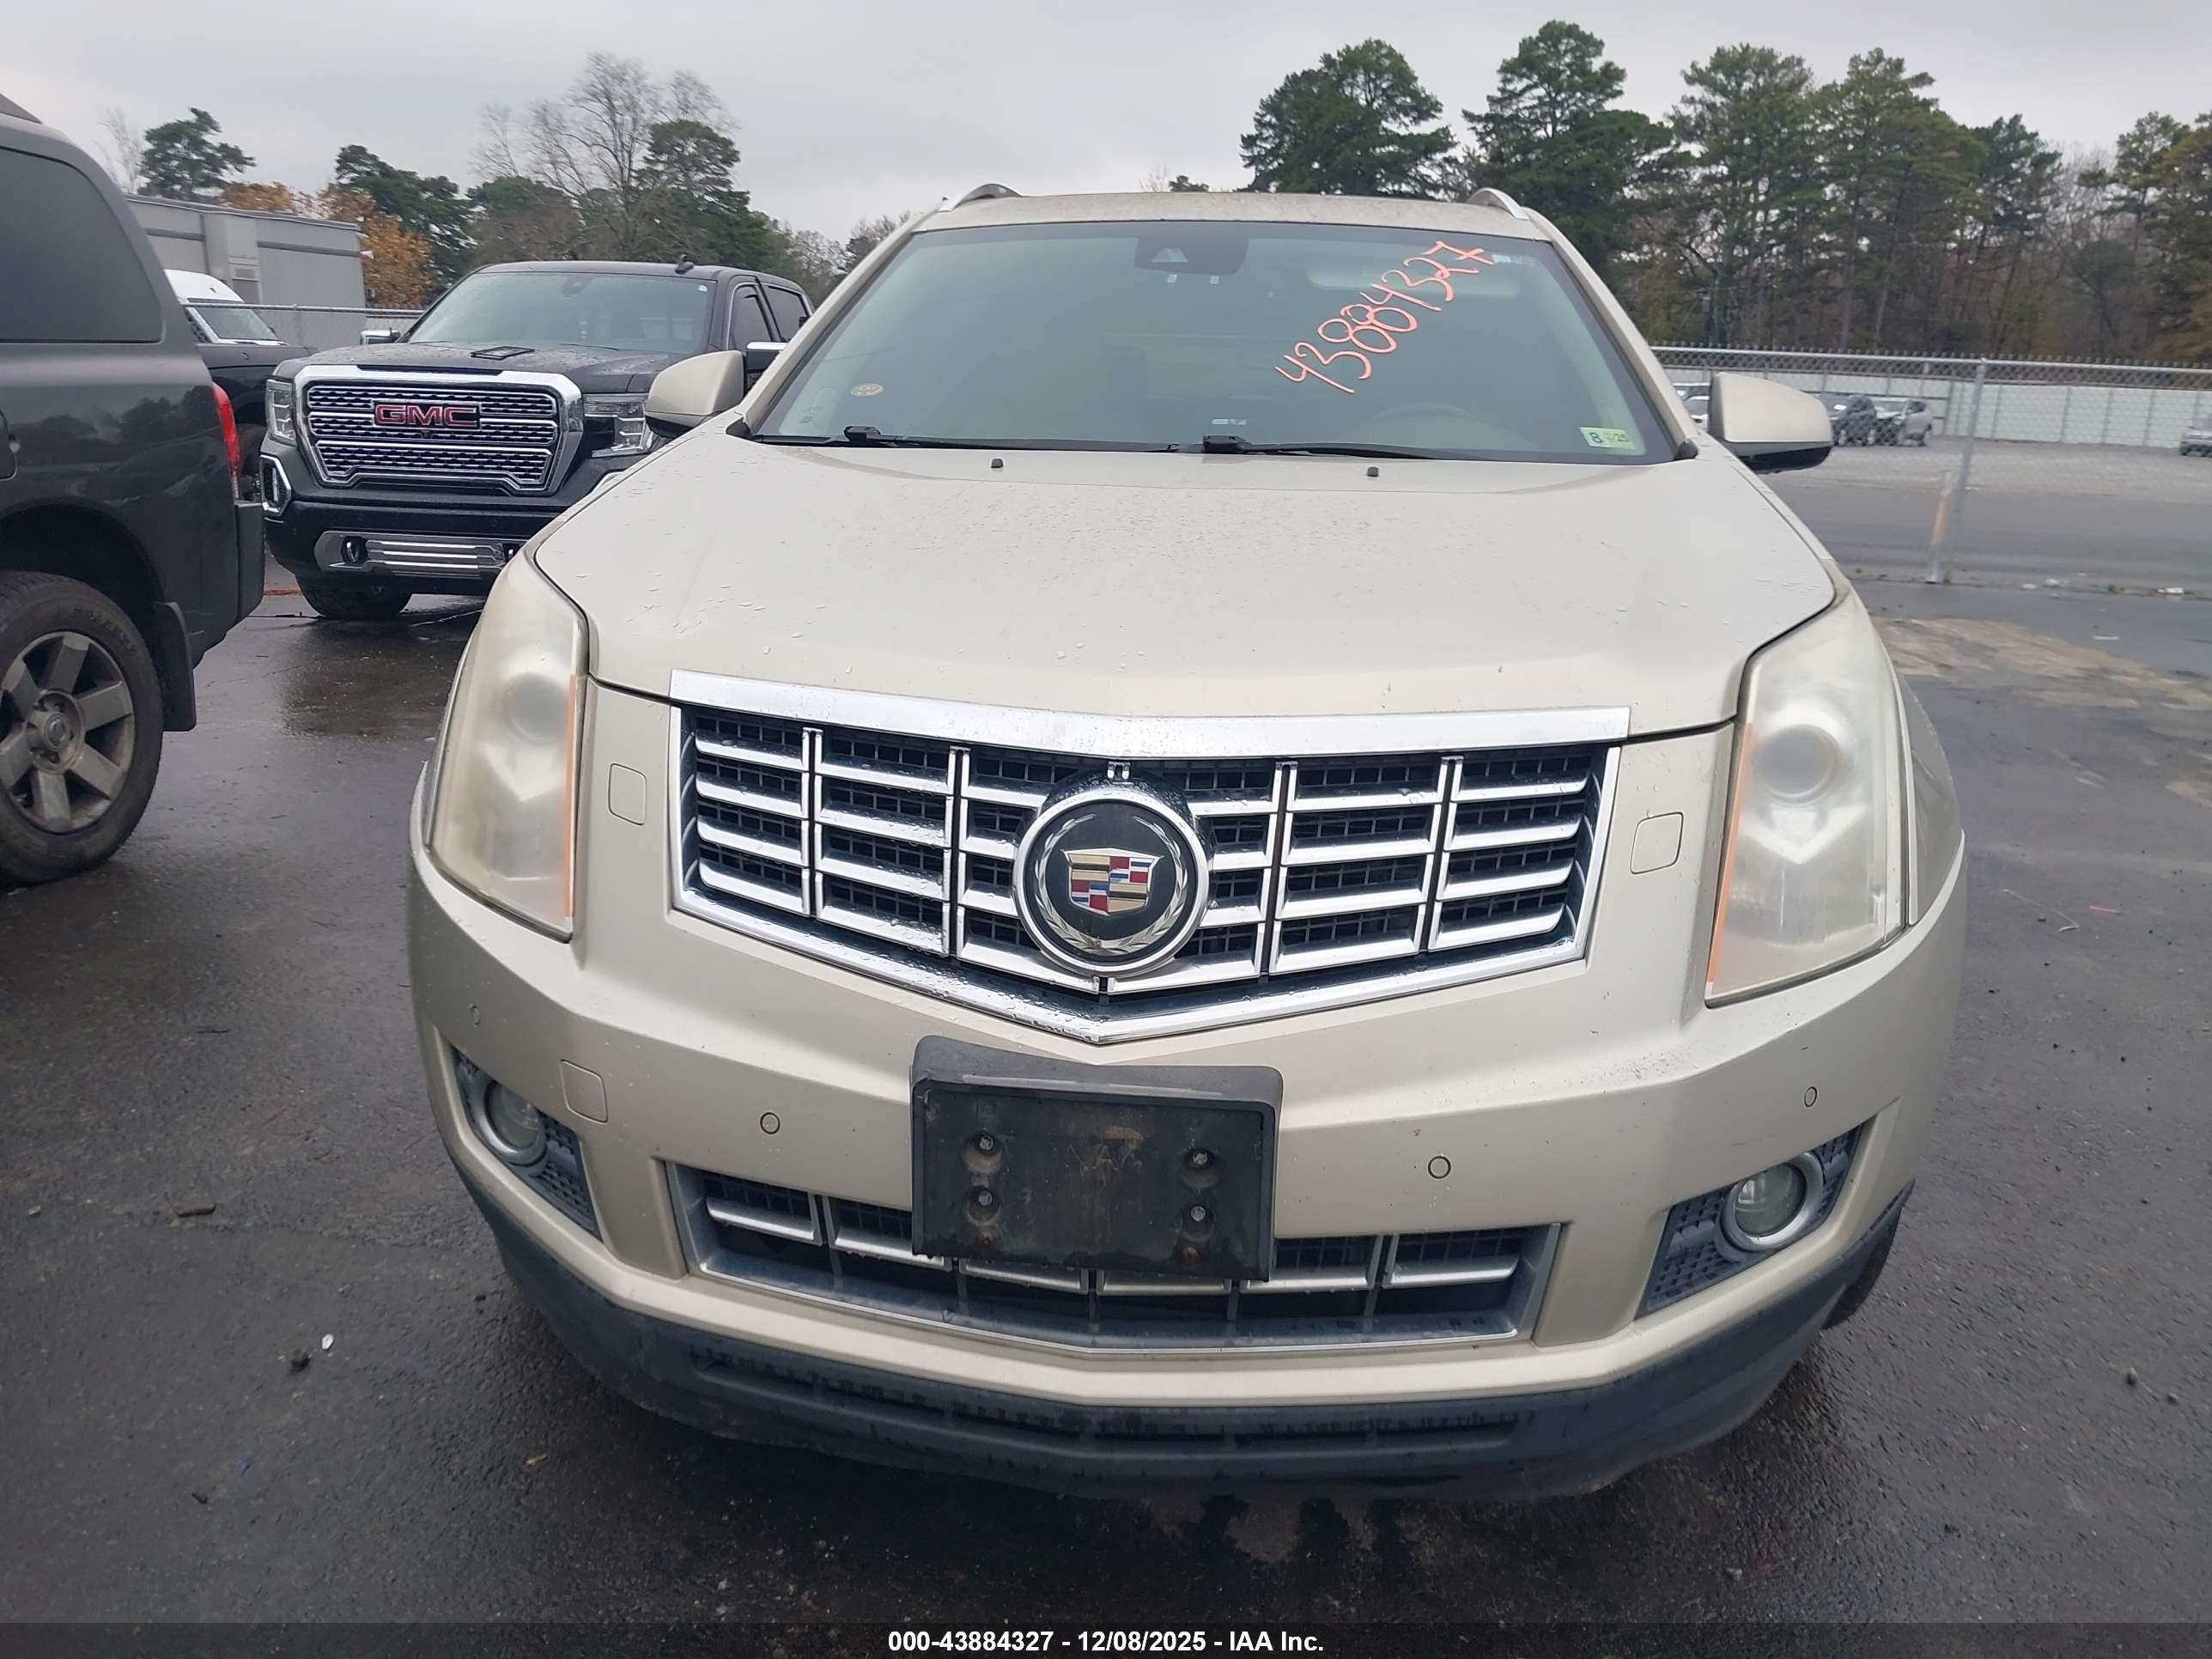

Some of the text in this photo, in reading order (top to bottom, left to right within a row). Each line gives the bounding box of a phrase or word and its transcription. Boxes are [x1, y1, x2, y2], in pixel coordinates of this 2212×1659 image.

[1275, 240, 1496, 393] 43884327
[375, 404, 477, 427] GMC
[1589, 432, 1603, 443] 8
